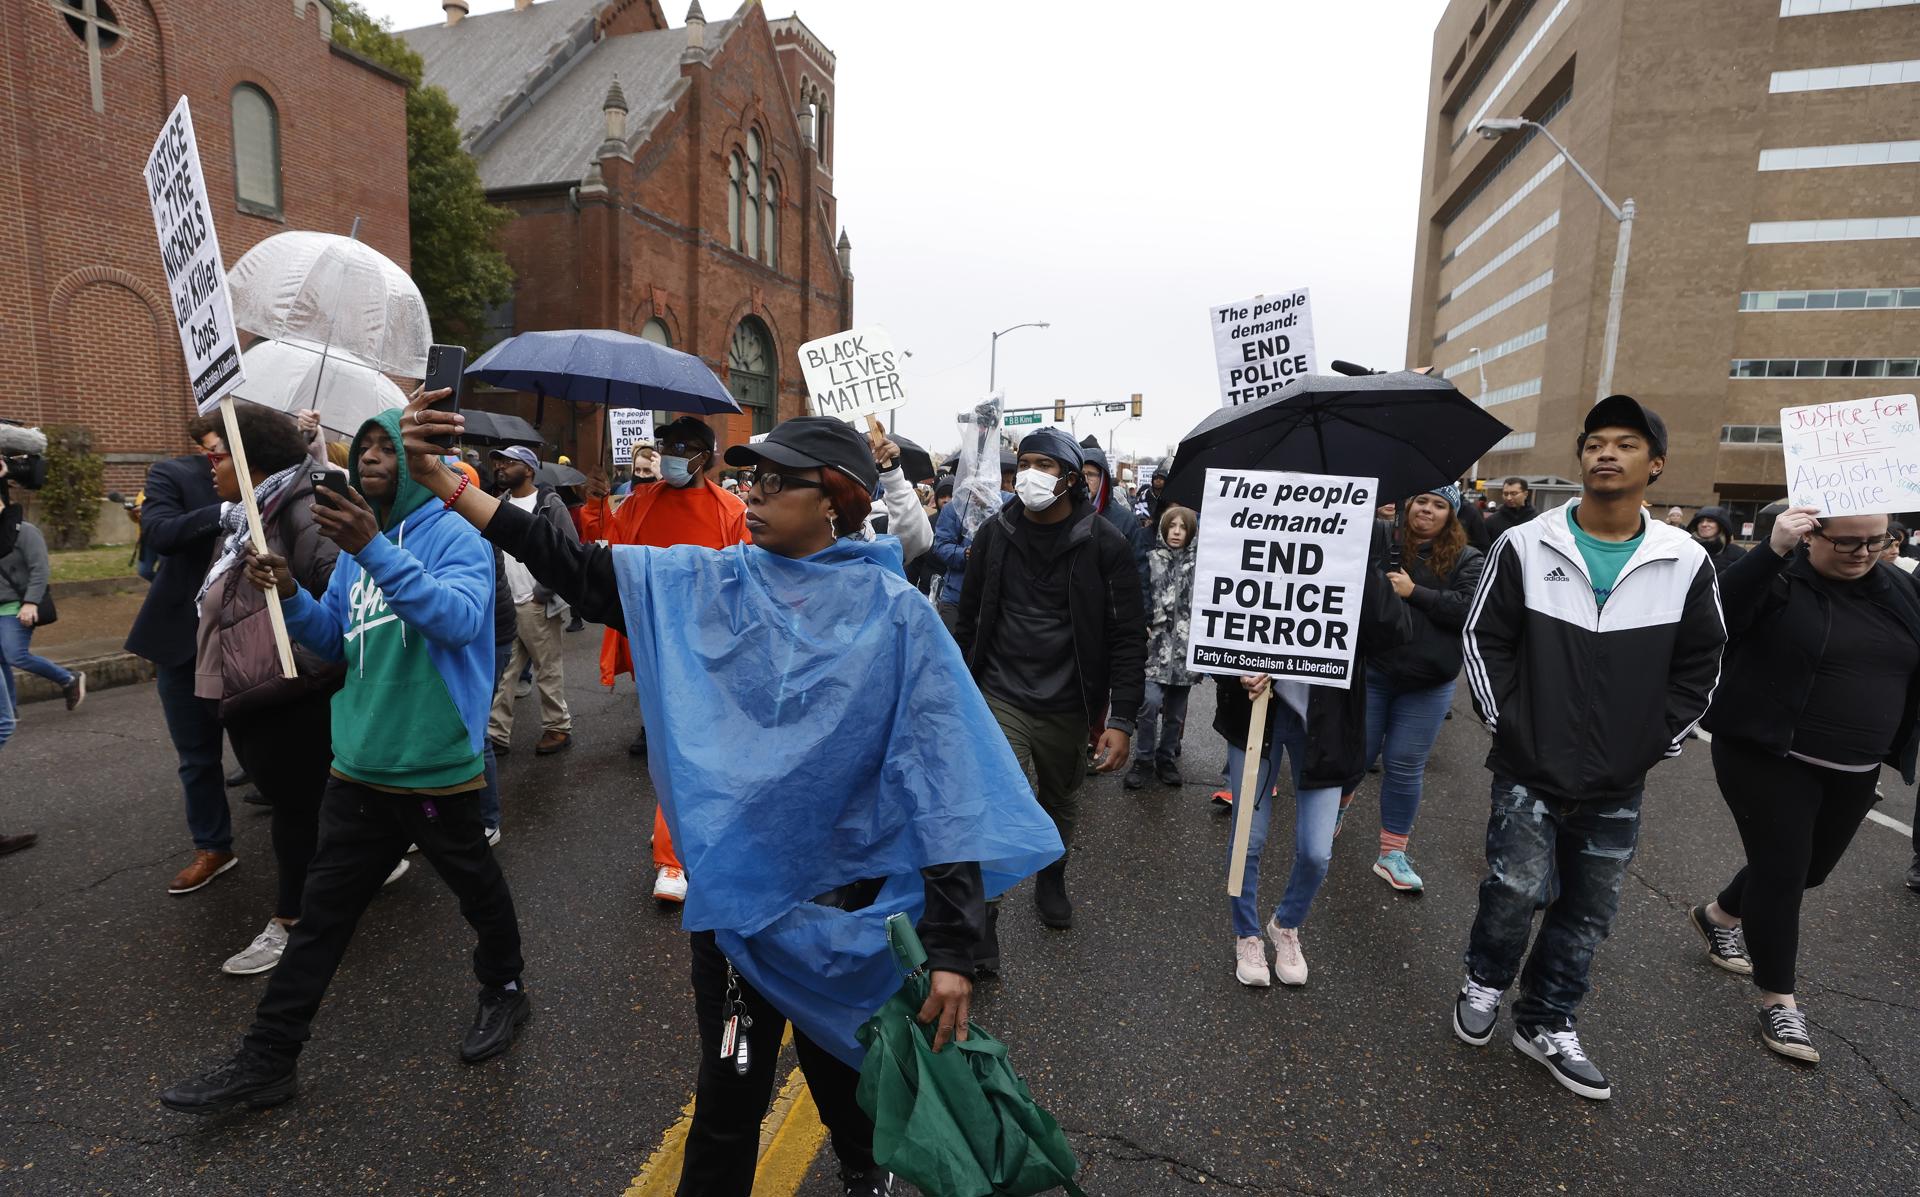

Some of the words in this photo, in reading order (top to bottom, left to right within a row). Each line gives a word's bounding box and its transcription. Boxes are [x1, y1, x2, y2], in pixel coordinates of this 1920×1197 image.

[150, 112, 187, 205] JUSTICE
[165, 160, 194, 227] TYRE
[163, 200, 206, 284] NICHOLS
[176, 282, 193, 328] Jail
[189, 257, 218, 311] Killer
[1219, 308, 1248, 323] The
[1253, 293, 1306, 320] people
[191, 304, 220, 360] Cops!
[1231, 313, 1298, 339] demand:
[806, 335, 868, 368] BLACK
[1242, 335, 1290, 362] END
[829, 351, 895, 385] LIVES
[1230, 355, 1308, 387] POLICE
[817, 373, 904, 416] MATTER
[1872, 399, 1908, 420] for
[622, 427, 642, 436] END
[1800, 427, 1884, 455] TYRE
[1793, 461, 1877, 492] Abolish
[1880, 458, 1918, 482] the
[1219, 476, 1268, 499] The
[1273, 482, 1368, 509] people
[1230, 507, 1348, 535] demand:
[1241, 539, 1324, 575] END
[1212, 576, 1346, 615] POLICE
[1201, 609, 1349, 651] TERROR
[1197, 649, 1222, 664] Party
[1223, 652, 1237, 664] for
[1239, 654, 1284, 670] Socialism
[1286, 658, 1294, 670] &
[1296, 659, 1345, 675] Liberation
